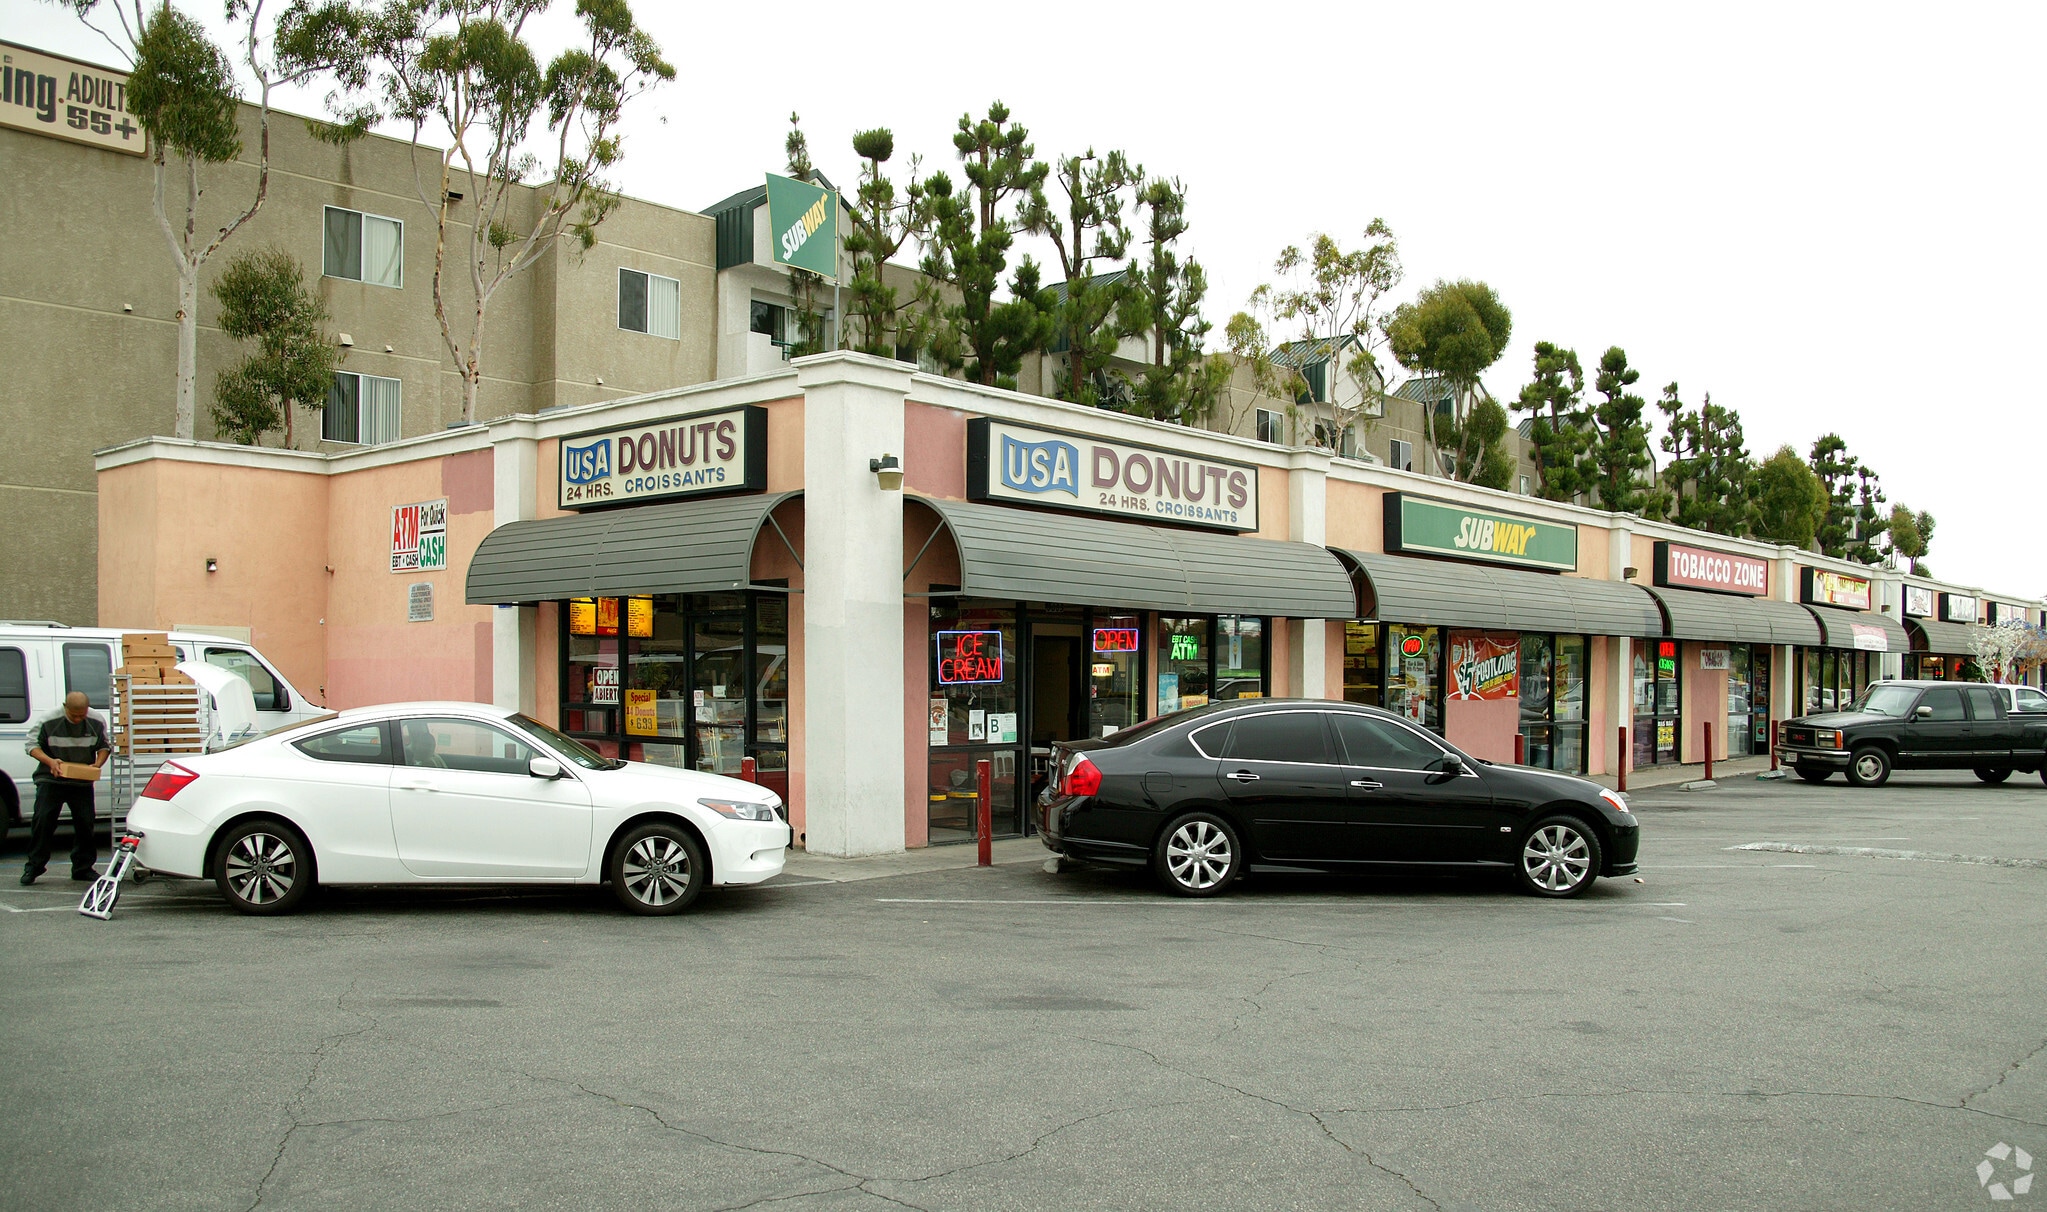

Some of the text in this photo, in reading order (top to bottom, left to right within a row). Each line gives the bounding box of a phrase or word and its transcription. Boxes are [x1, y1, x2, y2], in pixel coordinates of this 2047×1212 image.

[0, 55, 130, 123] ing ADULT
[67, 105, 137, 140] 55+
[781, 192, 828, 261] SUBWAY
[568, 419, 736, 480] USA DONUTS
[567, 467, 726, 500] 24 HRS. CROISSANTS
[1008, 443, 1248, 510] USA DONUTS
[1099, 492, 1238, 523] 24 HRS. CROISSANTS
[393, 506, 418, 550] ATM
[1453, 516, 1536, 556] SUBWAY
[392, 554, 418, 567] EBT CASH
[419, 536, 445, 567] CASH
[1672, 551, 1764, 588] TOBACCO ZONE
[956, 632, 983, 657] ICE
[1095, 630, 1137, 650] OPEN
[1171, 643, 1197, 660] ATM
[1172, 635, 1182, 643] EBT
[1404, 639, 1420, 652] OPEN
[1660, 642, 1675, 657] OPEN
[597, 670, 619, 685] OPEN
[940, 657, 1001, 682] CREAM
[595, 688, 618, 700] ABIERT
[631, 692, 651, 704] Special
[635, 706, 655, 716] Donuts
[991, 719, 999, 733] B
